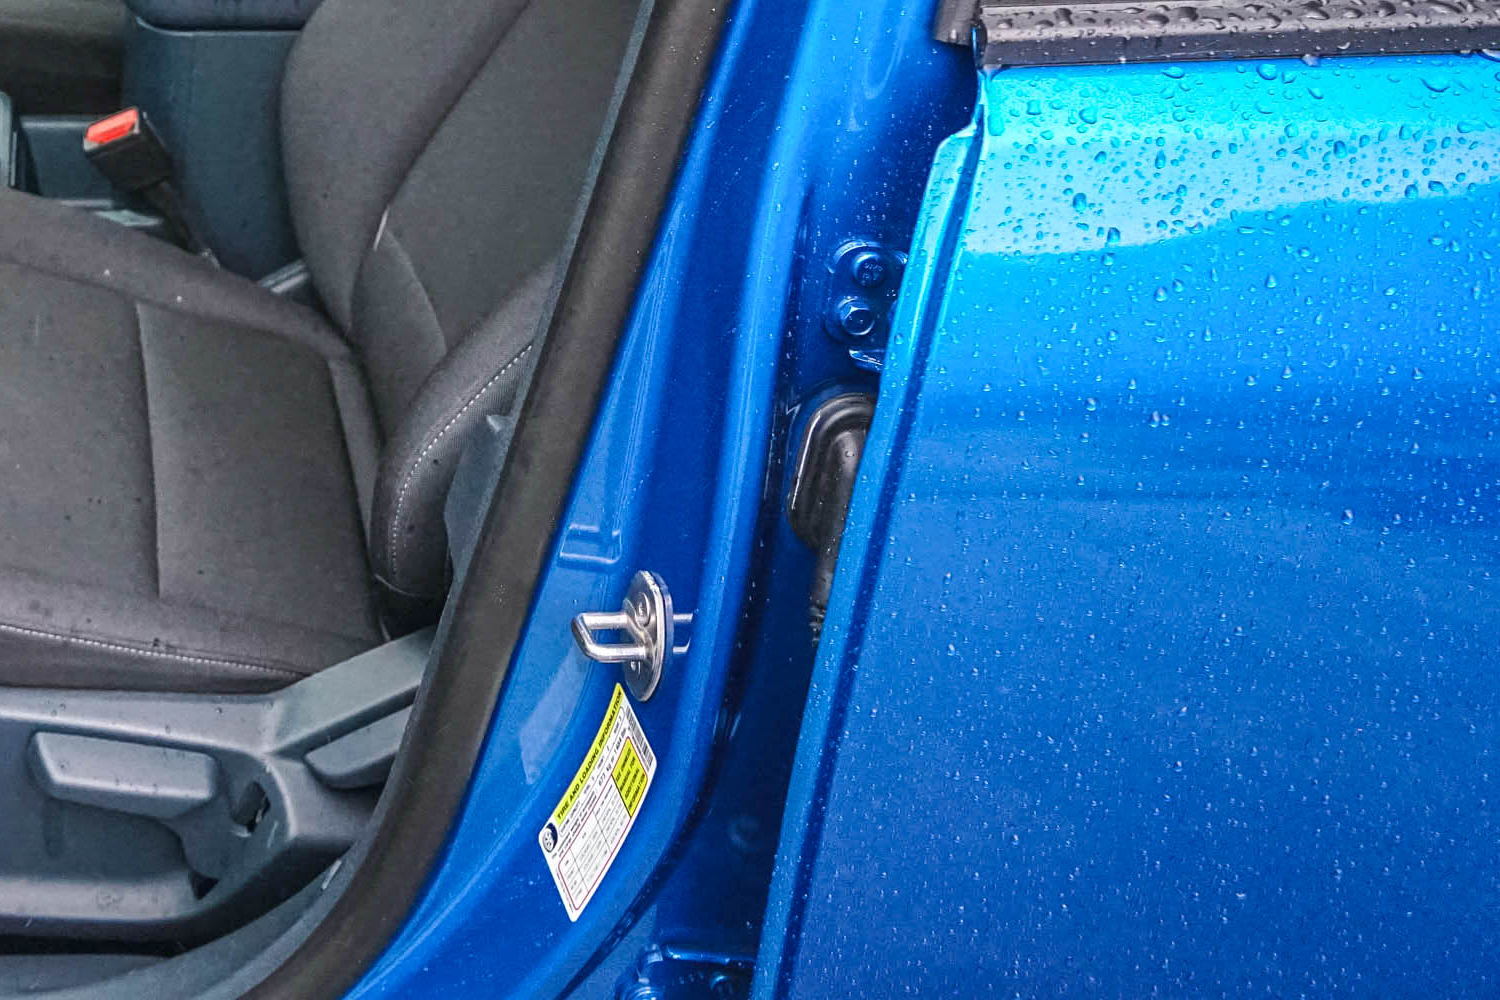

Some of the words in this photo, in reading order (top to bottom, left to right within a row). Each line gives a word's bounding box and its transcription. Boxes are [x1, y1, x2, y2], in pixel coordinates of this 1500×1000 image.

[557, 800, 569, 820] TIRE
[570, 784, 580, 800] AND
[579, 748, 599, 783] LOADING
[598, 691, 622, 748] INFORMATION
